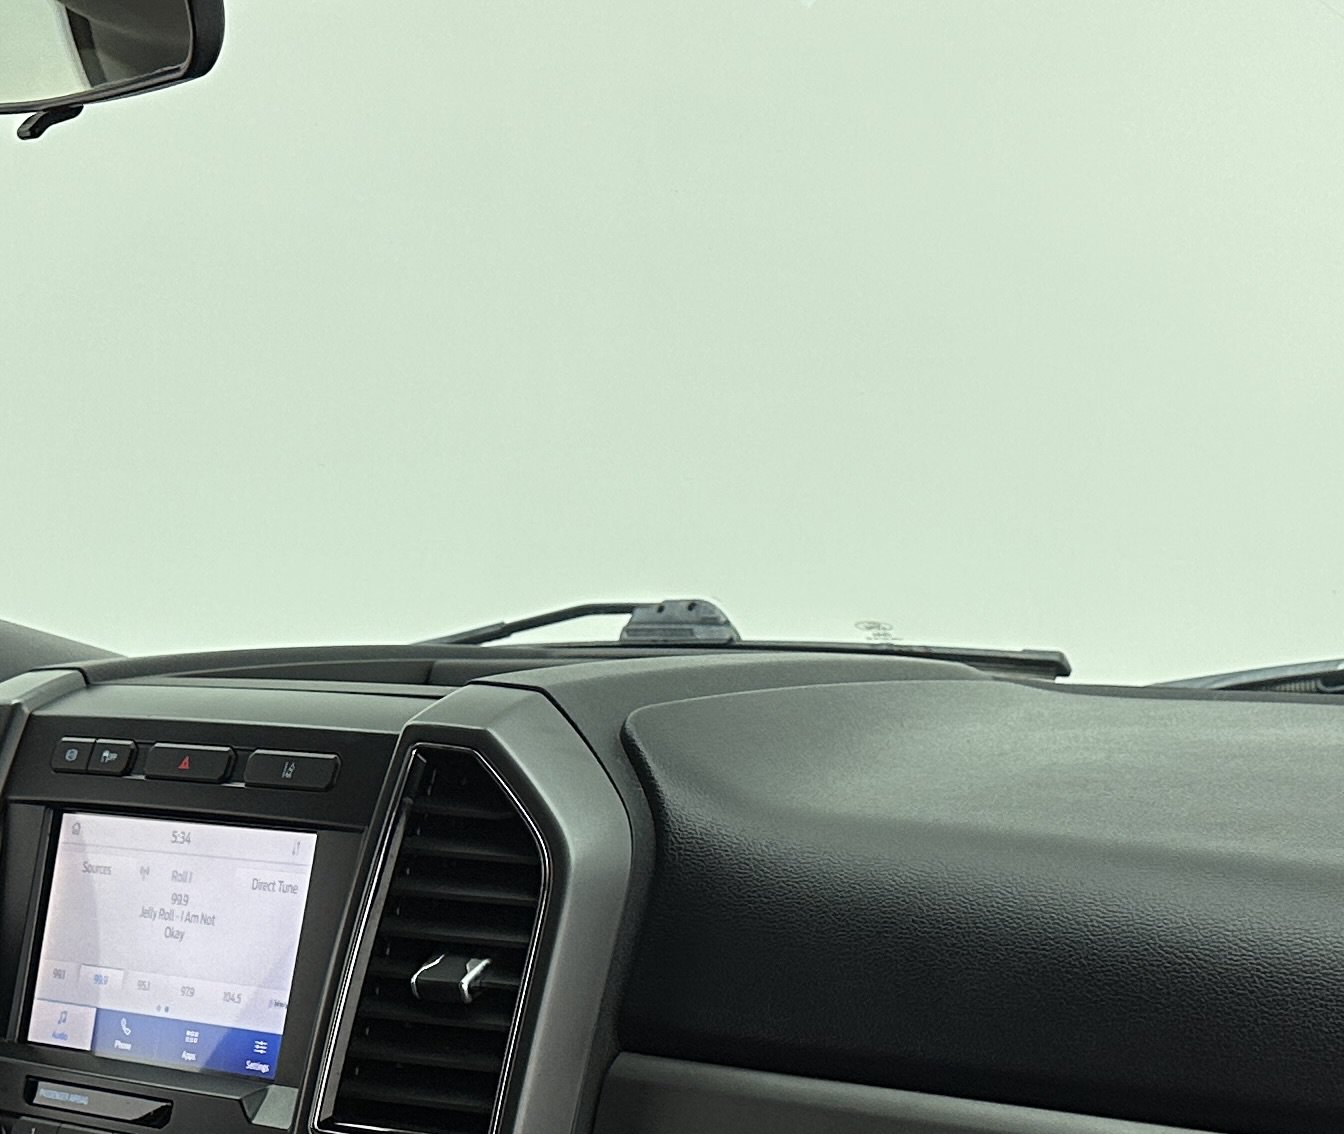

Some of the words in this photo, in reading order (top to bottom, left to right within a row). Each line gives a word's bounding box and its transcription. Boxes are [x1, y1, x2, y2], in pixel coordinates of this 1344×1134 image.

[170, 830, 192, 845] 5:34
[81, 861, 112, 876] Sources
[251, 878, 276, 893] Direct
[277, 880, 299, 895] Tune
[139, 904, 157, 922] Jelly
[158, 907, 175, 922] Roll
[200, 913, 216, 927] Not
[164, 926, 186, 943] Okay
[245, 1060, 270, 1074] Settings
